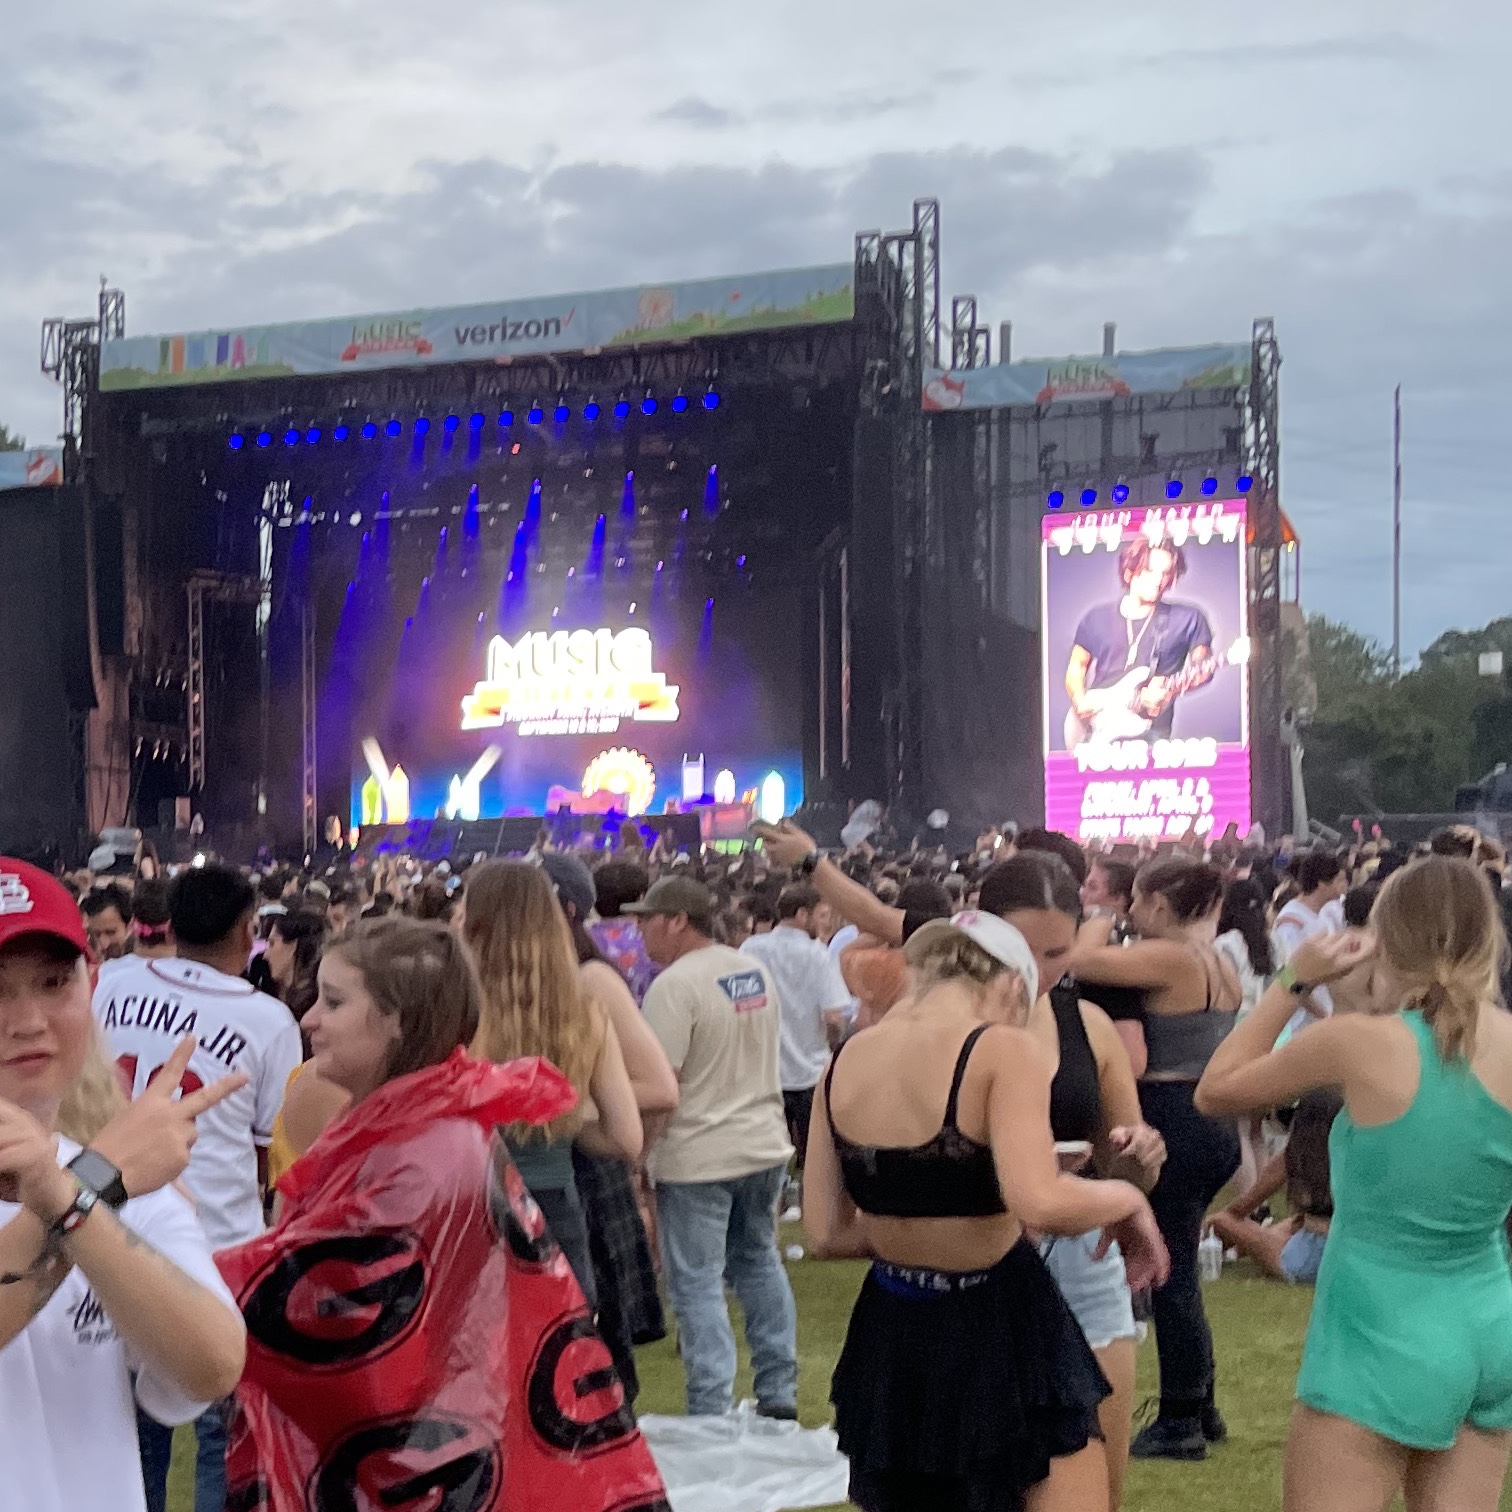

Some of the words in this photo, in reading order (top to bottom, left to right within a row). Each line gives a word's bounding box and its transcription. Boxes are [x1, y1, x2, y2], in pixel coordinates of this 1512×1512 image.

[454, 315, 561, 345] verizon
[486, 627, 652, 682] MUSIC
[242, 1234, 426, 1364] G
